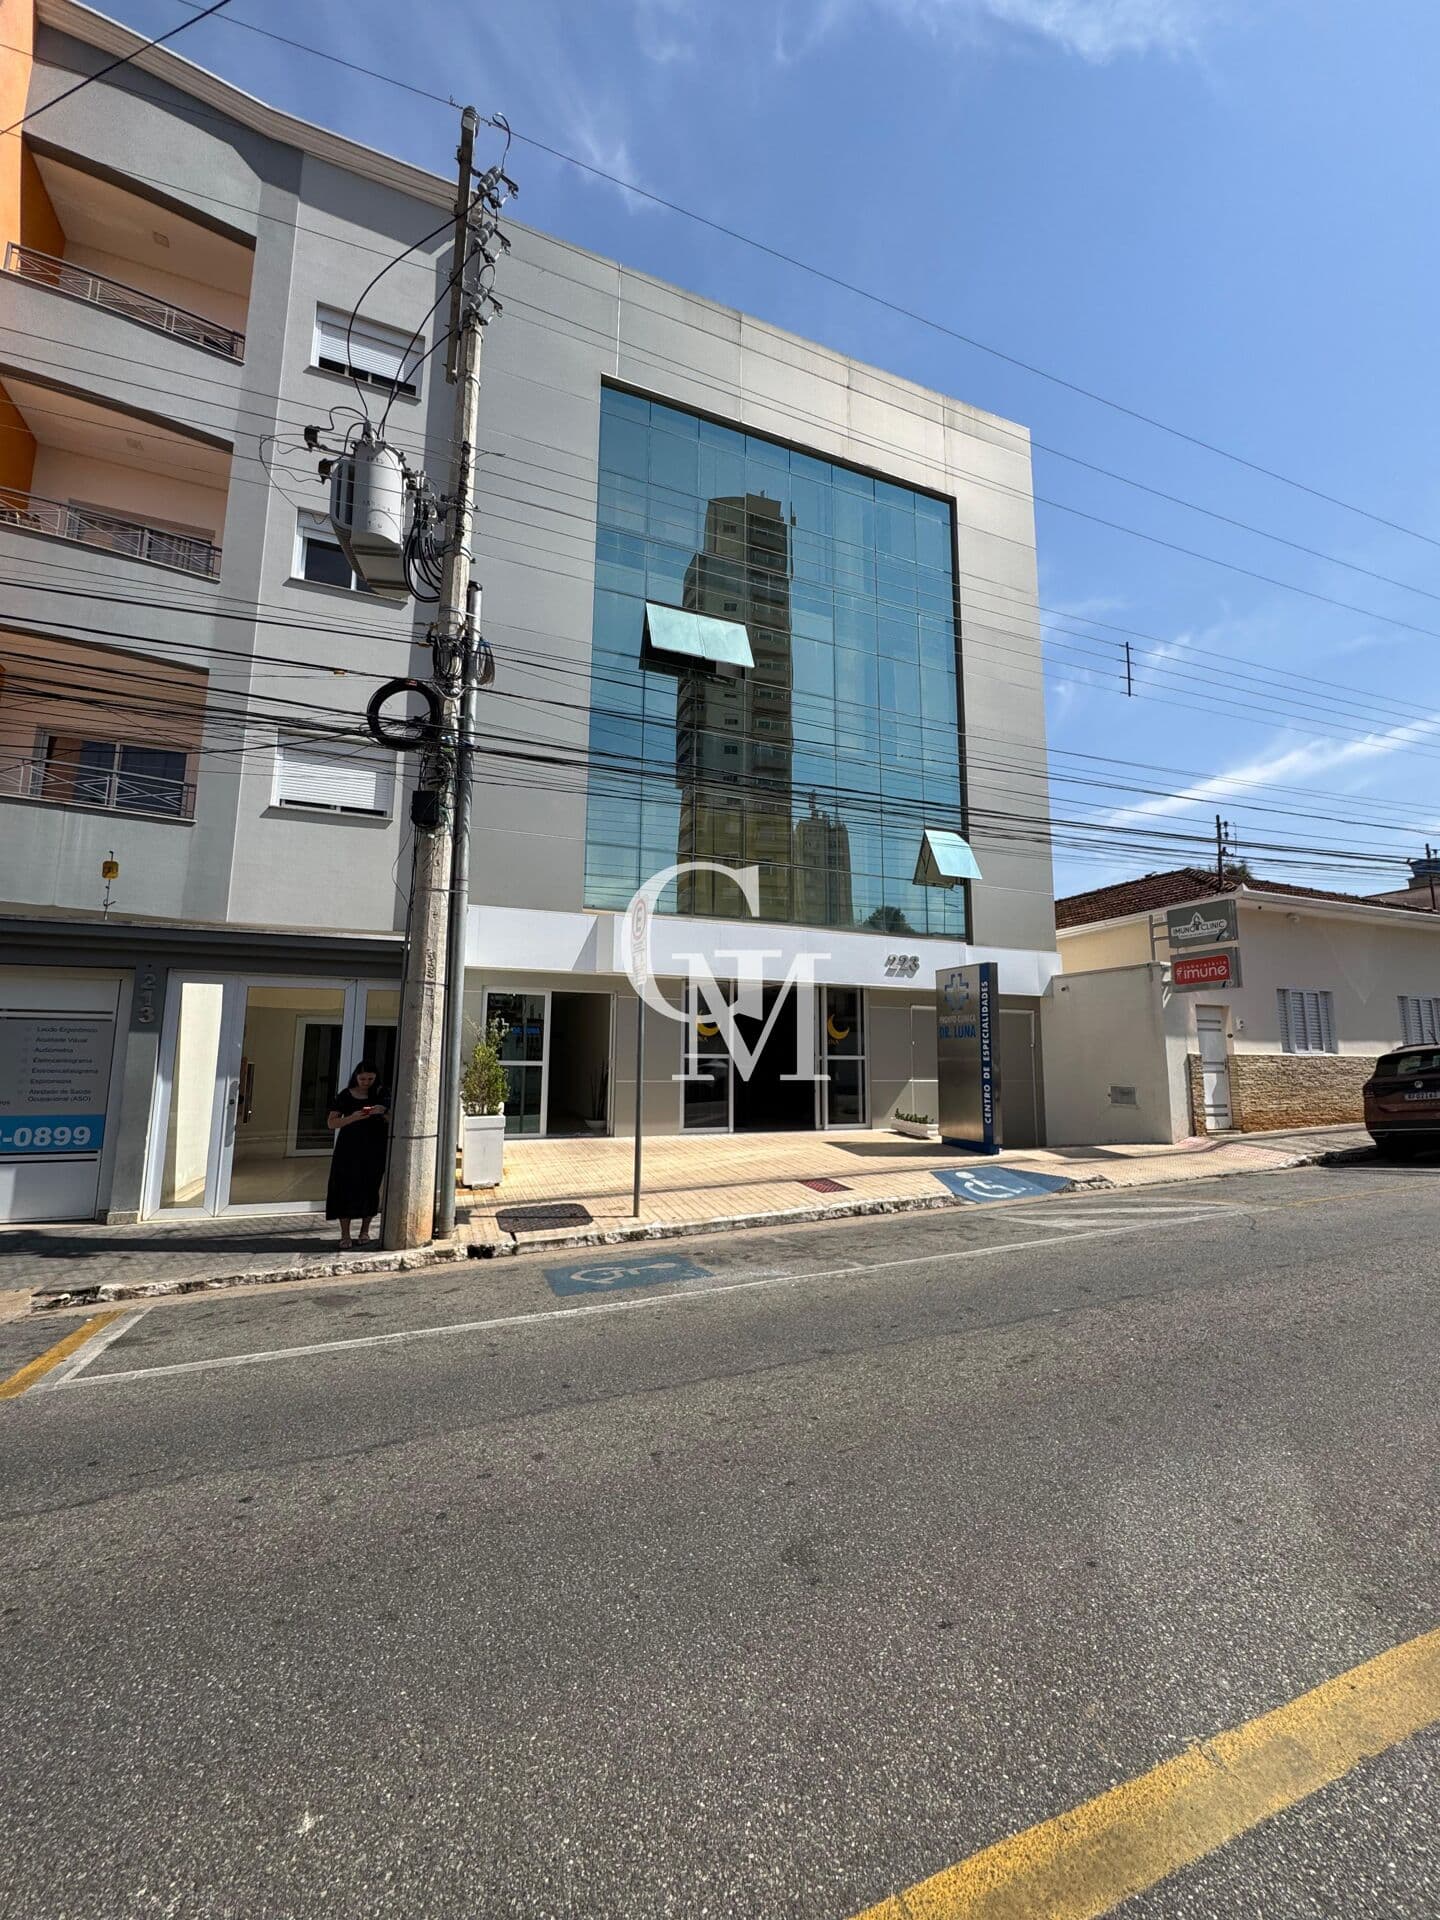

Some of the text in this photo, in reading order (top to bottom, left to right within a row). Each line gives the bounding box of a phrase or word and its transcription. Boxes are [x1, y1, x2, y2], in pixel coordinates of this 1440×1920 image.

[1183, 965, 1227, 980] imune
[953, 1024, 976, 1039] LUNA
[981, 980, 992, 1124] CENTRO DE ESPECIALIDADES
[0, 1126, 91, 1147] -0899
